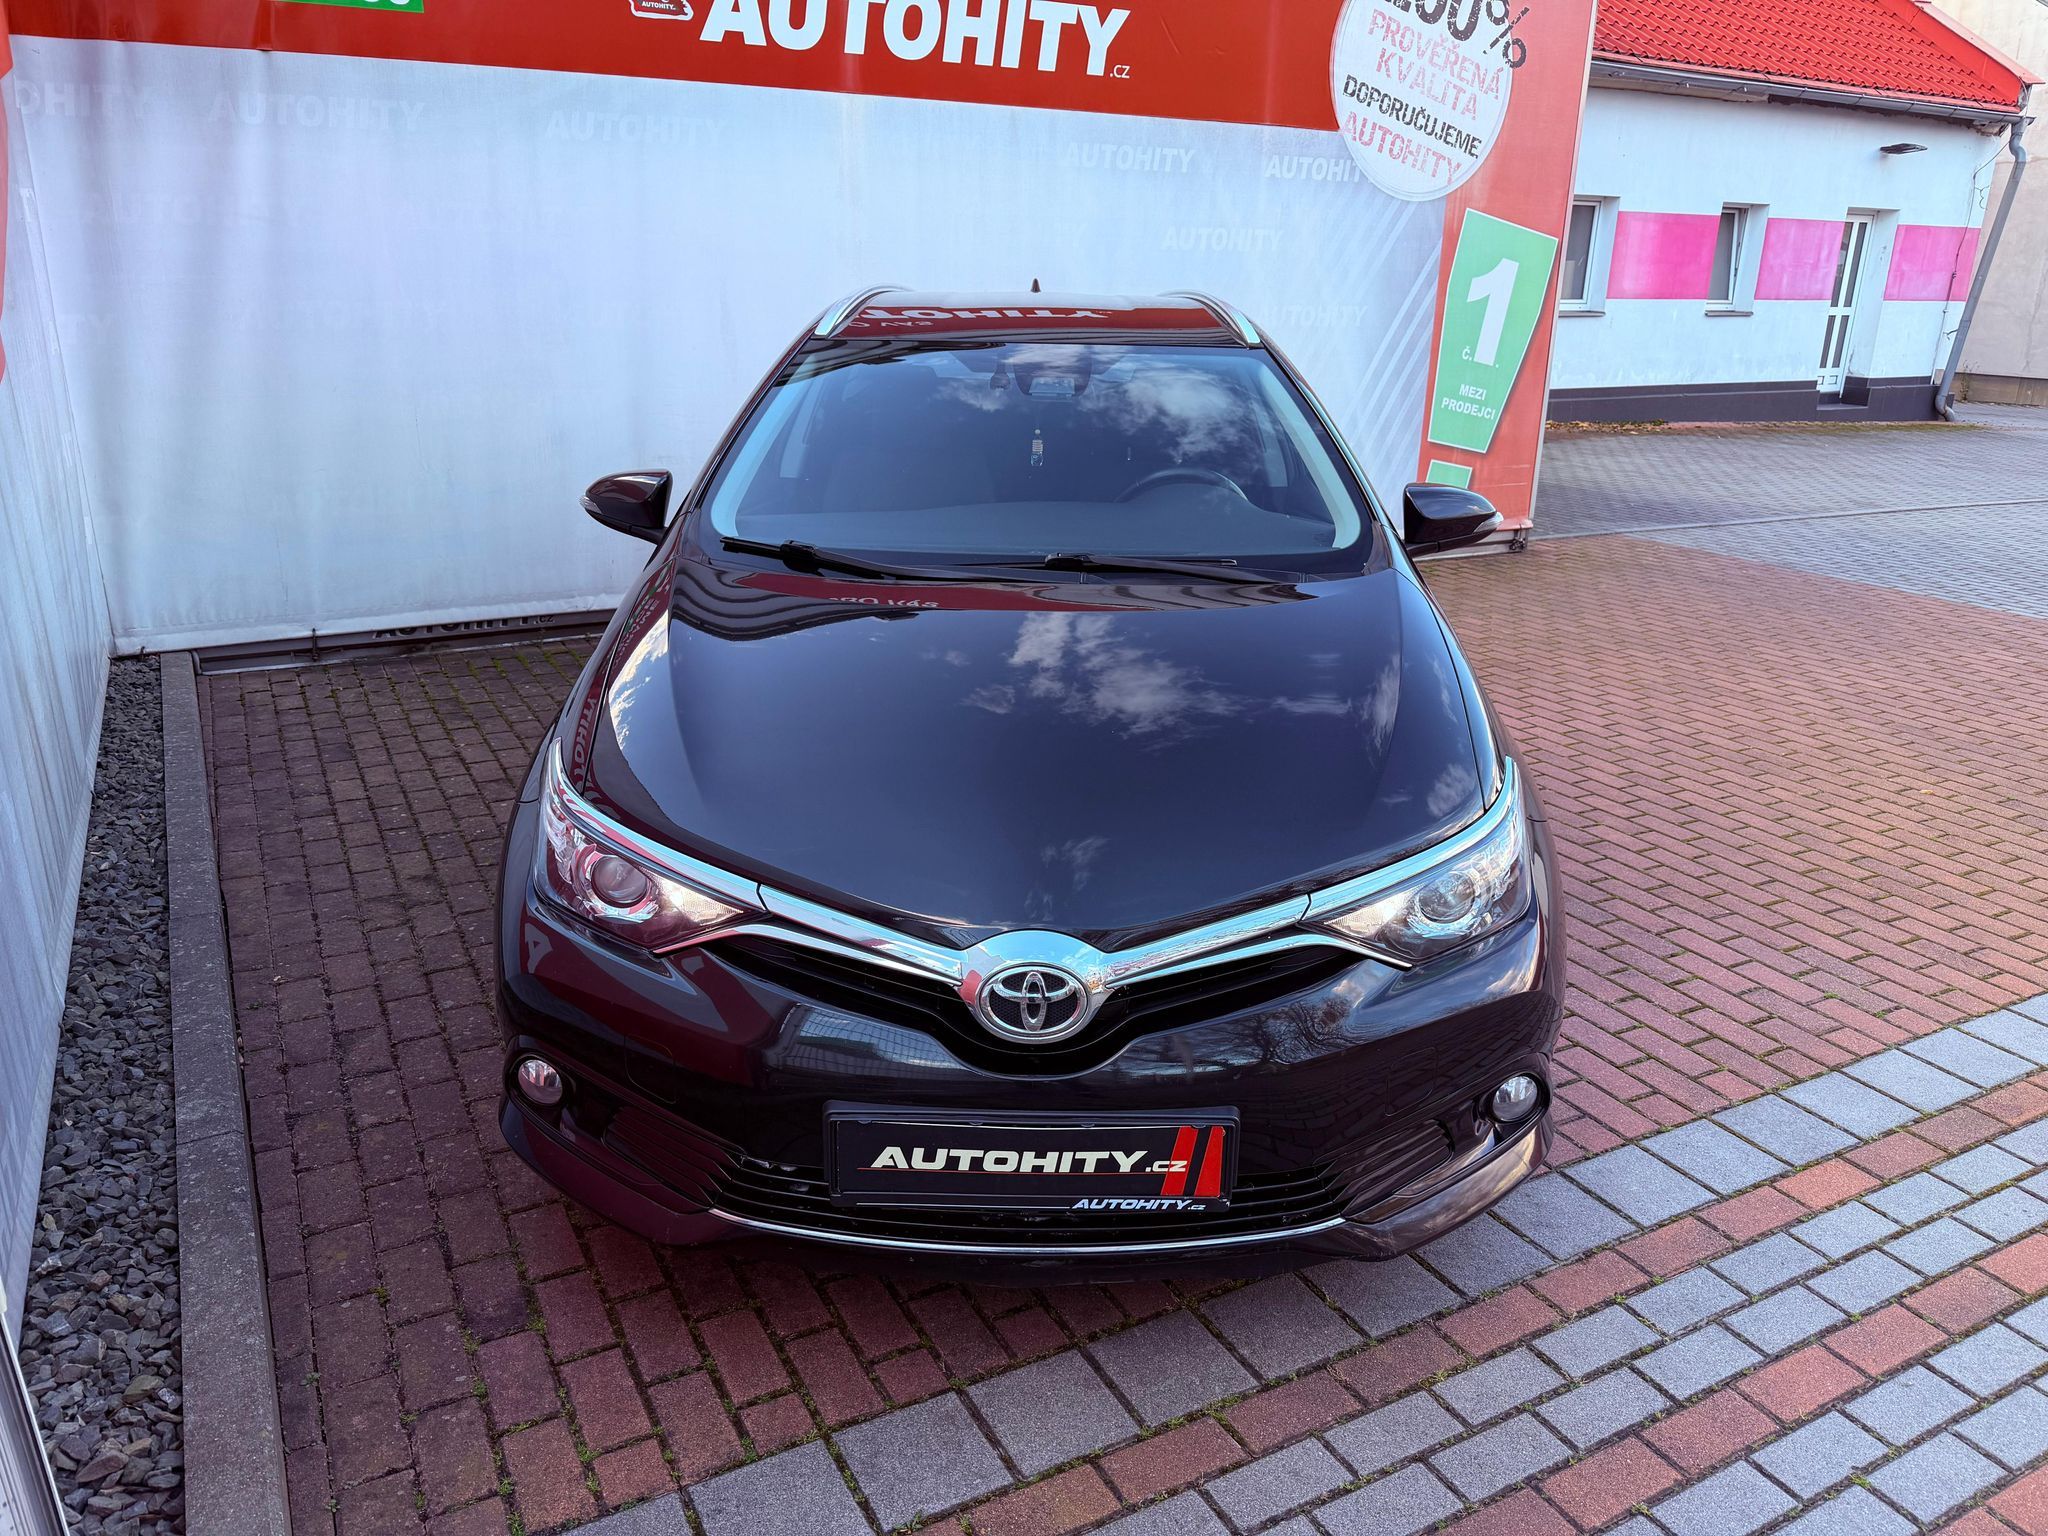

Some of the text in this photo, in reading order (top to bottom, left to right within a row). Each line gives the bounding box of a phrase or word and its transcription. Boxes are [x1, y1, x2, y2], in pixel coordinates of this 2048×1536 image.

[1368, 8, 1504, 101] PROVĚŘENÁ
[1376, 48, 1477, 121] KVALITA
[1342, 73, 1482, 159] DOPORUČUJEME
[1342, 111, 1463, 186] AUTOHITY
[1062, 142, 1197, 174] AUTOHITY
[1440, 397, 1496, 420] PRODEJCI
[1458, 383, 1487, 401] MEZI
